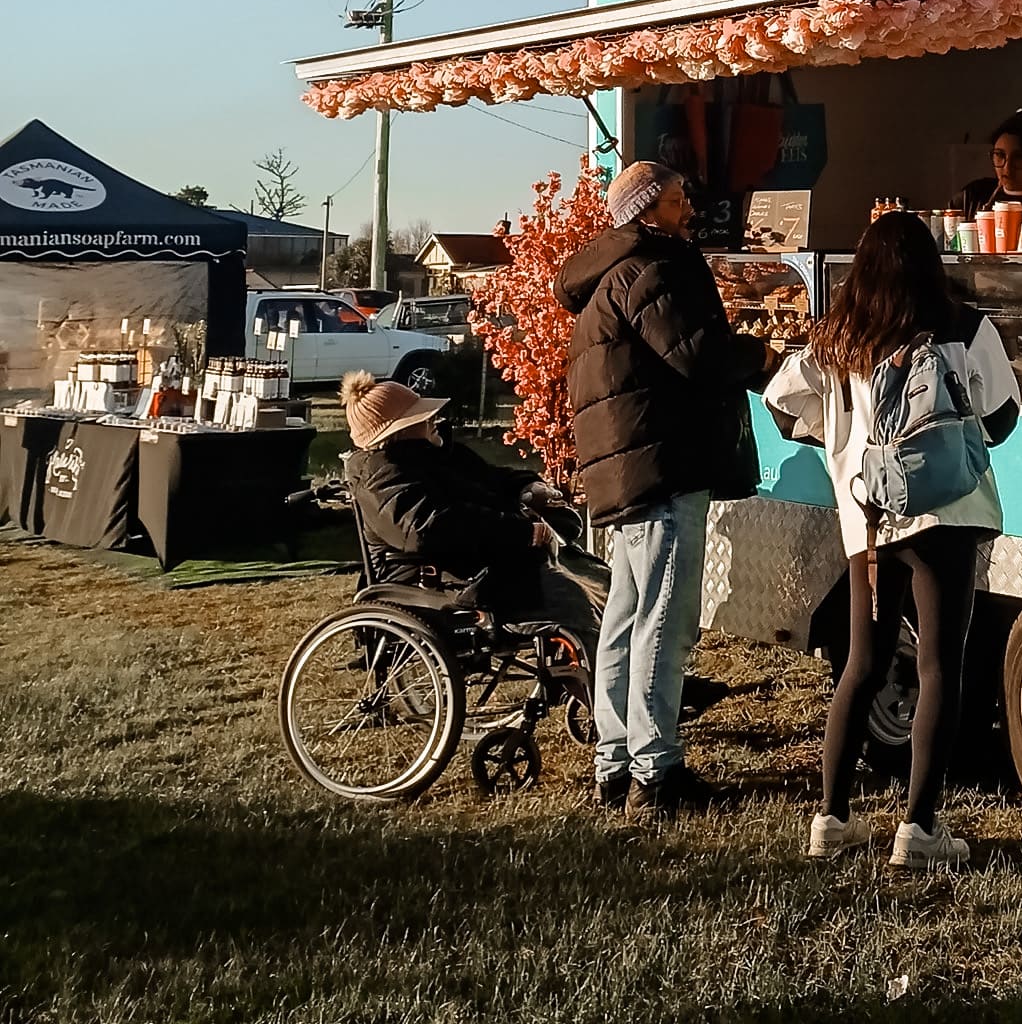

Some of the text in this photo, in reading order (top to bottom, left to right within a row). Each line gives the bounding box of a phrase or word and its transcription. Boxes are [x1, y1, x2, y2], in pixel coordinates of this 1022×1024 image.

[3, 162, 94, 183] TASMANIAN
[32, 200, 83, 210] MADE
[0, 231, 200, 248] maniansoapfarm.com
